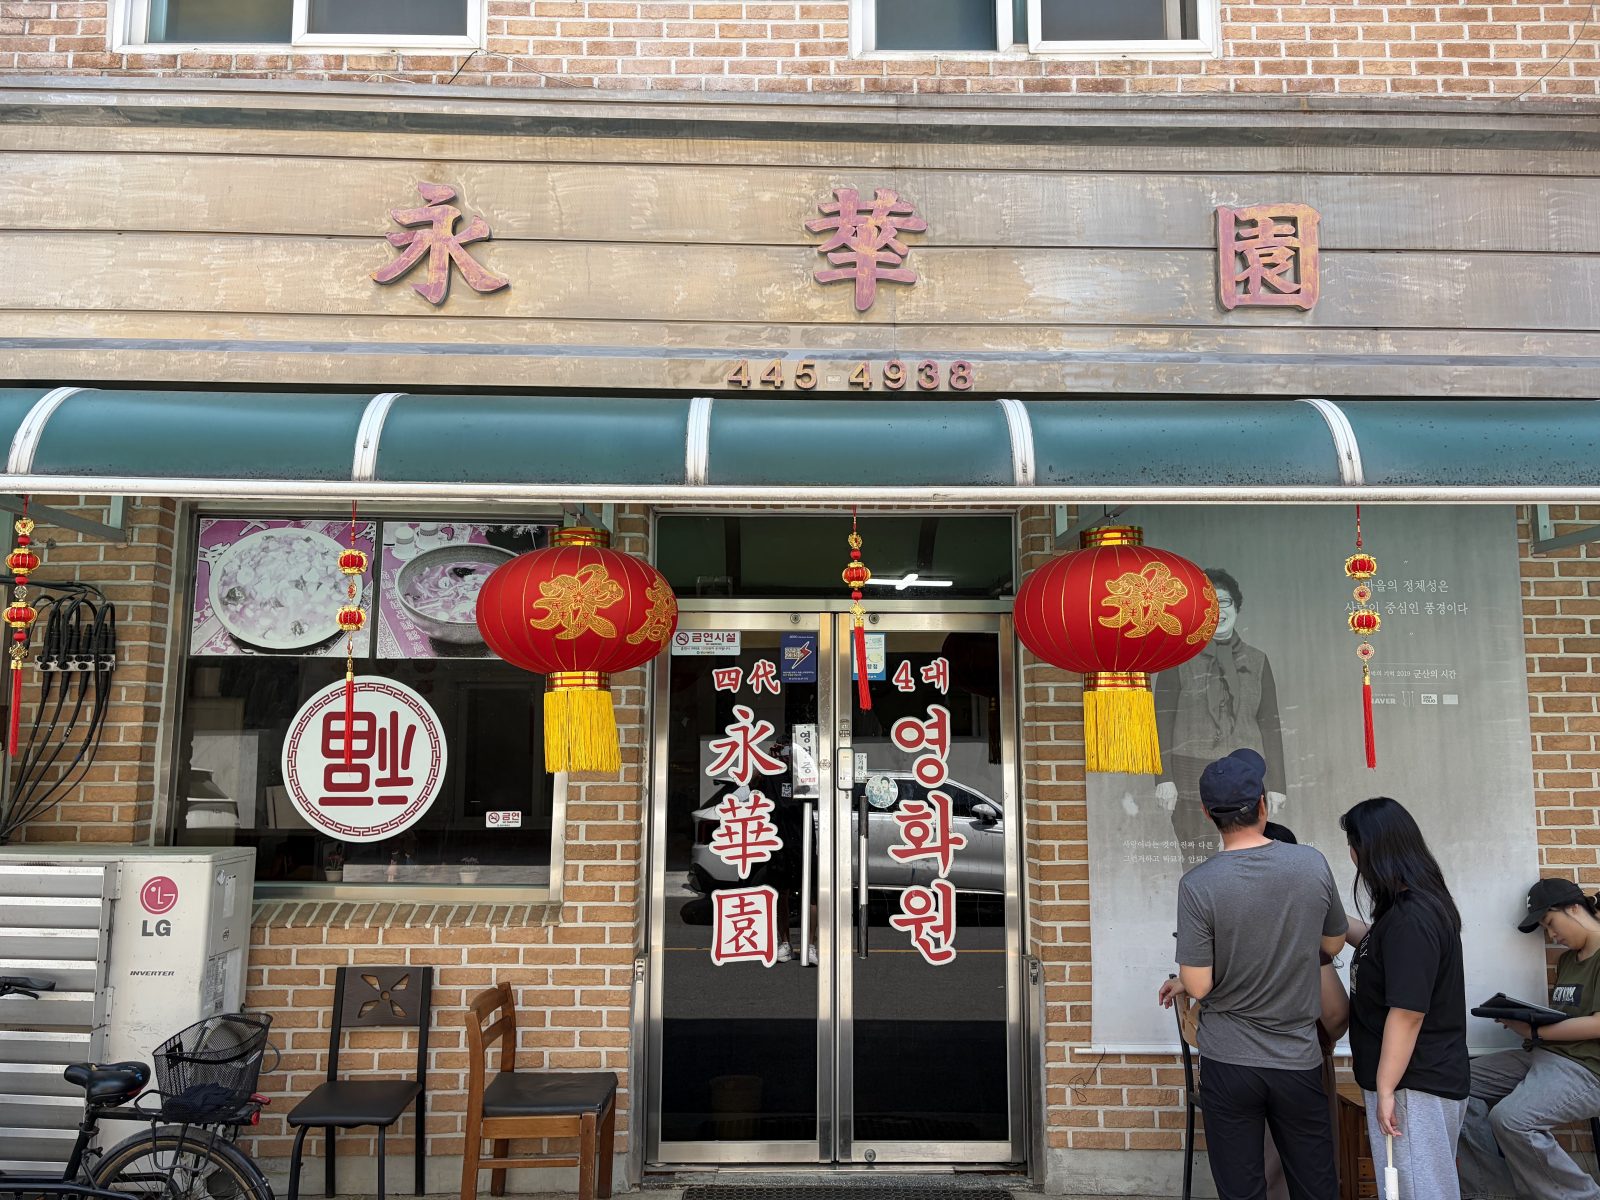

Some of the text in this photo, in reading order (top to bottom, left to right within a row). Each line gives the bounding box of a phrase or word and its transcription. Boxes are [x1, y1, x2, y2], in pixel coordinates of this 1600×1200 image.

[372, 182, 1320, 311] 永華園
[1363, 579, 1449, 593] 마을의 정체성은
[1384, 602, 1420, 615] 중심인
[1424, 602, 1469, 615] 풍경이다
[692, 632, 736, 643] 금연시설
[712, 659, 781, 694] 四代
[891, 656, 950, 695] 4대
[1413, 669, 1438, 679] 군산의
[1441, 669, 1457, 680] 시간
[318, 710, 417, 806] 福
[502, 812, 520, 821] 금연
[705, 704, 787, 967] 永華園
[887, 704, 967, 966] 영화원
[1198, 841, 1214, 850] 다른
[141, 920, 172, 937] LG
